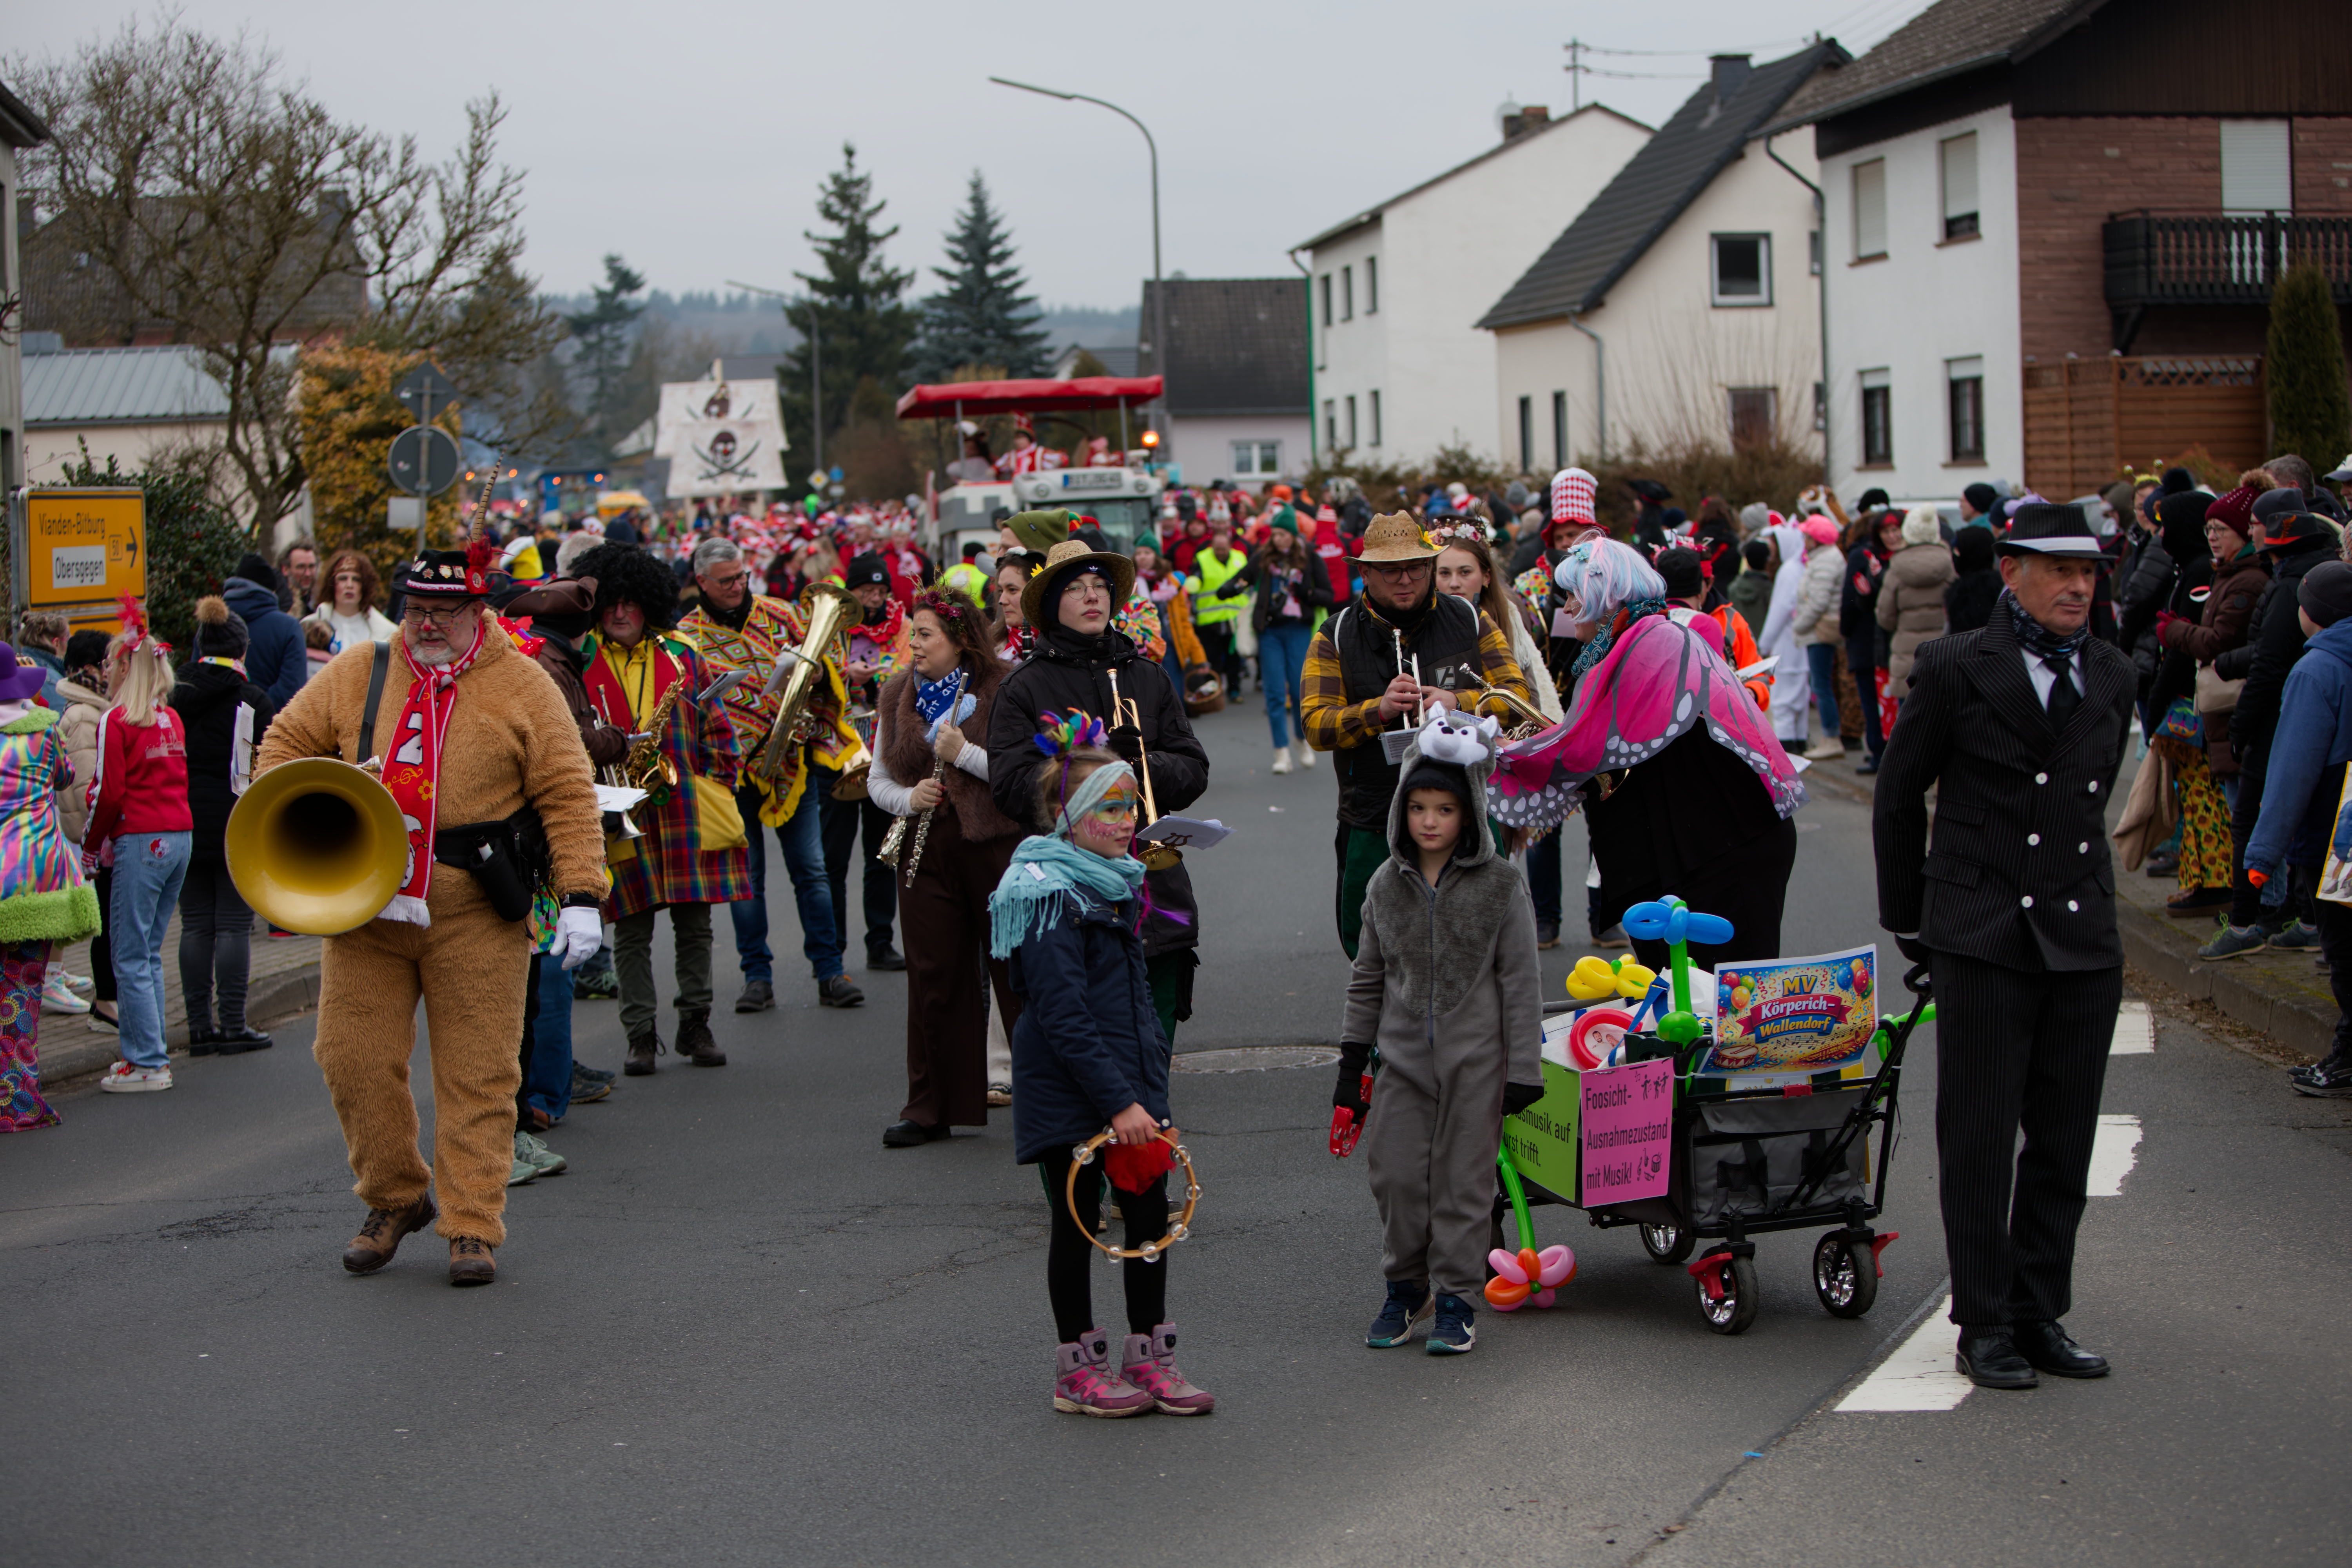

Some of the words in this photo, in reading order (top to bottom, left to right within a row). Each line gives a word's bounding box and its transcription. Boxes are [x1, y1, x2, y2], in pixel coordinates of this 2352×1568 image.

[38, 512, 105, 539] Vianden-Bitburg
[55, 556, 104, 583] Obersgegen
[1782, 975, 1817, 996] MV
[1761, 996, 1835, 1020] Körperich-
[1759, 1016, 1832, 1038] Wallendorf
[1586, 1083, 1632, 1111] Foosicht-
[1555, 1122, 1571, 1143] auf
[1586, 1117, 1668, 1150] Ausnahmezustand
[1503, 1132, 1519, 1154] urst
[1520, 1138, 1541, 1167] trifft.
[1587, 1167, 1601, 1189] mit
[1603, 1161, 1632, 1187] Musik!
